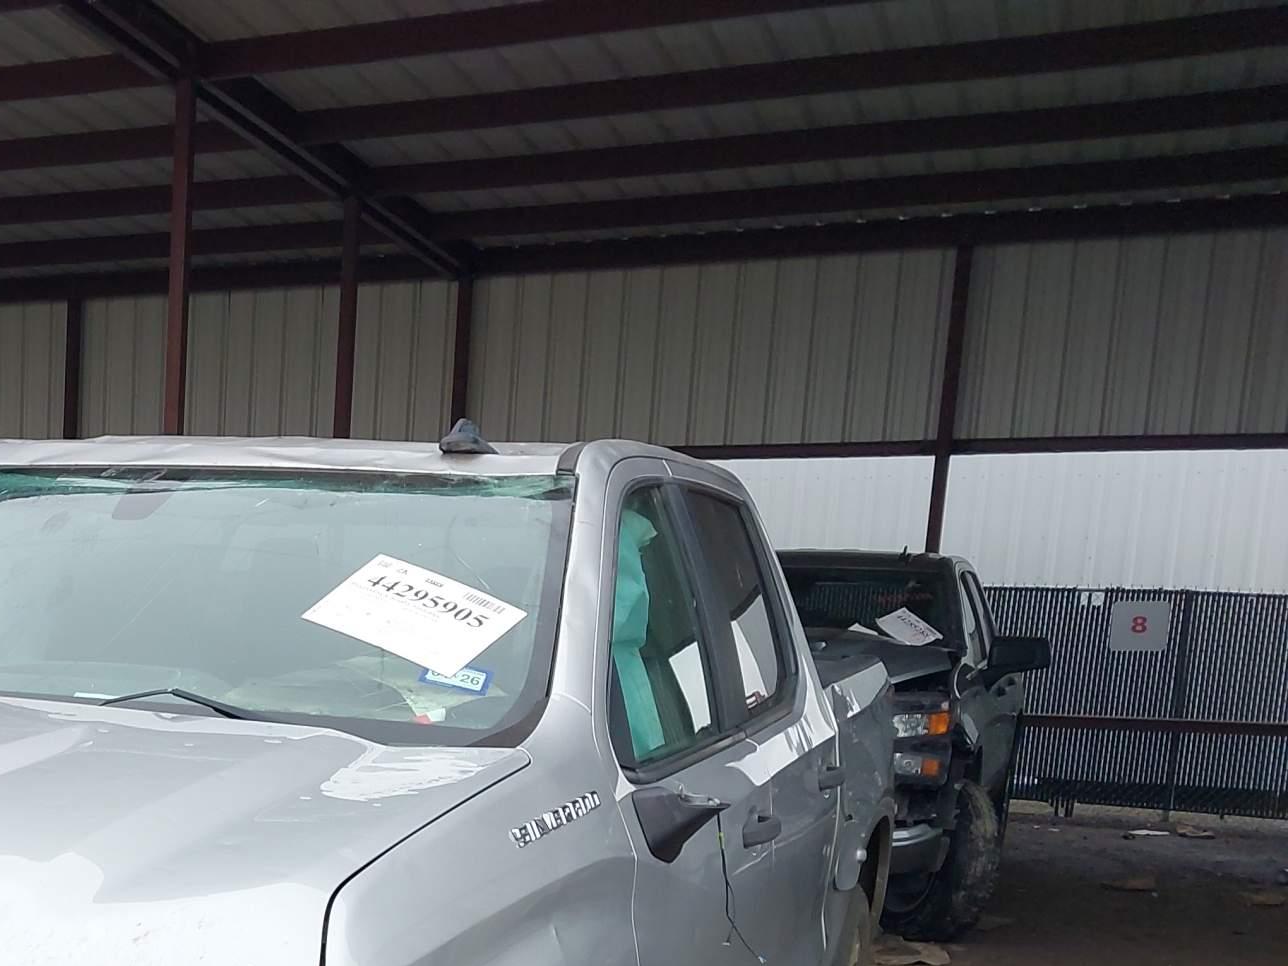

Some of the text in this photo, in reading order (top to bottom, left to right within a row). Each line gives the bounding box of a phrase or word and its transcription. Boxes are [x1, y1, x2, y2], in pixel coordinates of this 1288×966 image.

[367, 575, 490, 628] 44295905
[1131, 616, 1147, 633] 8
[460, 673, 481, 686] 26
